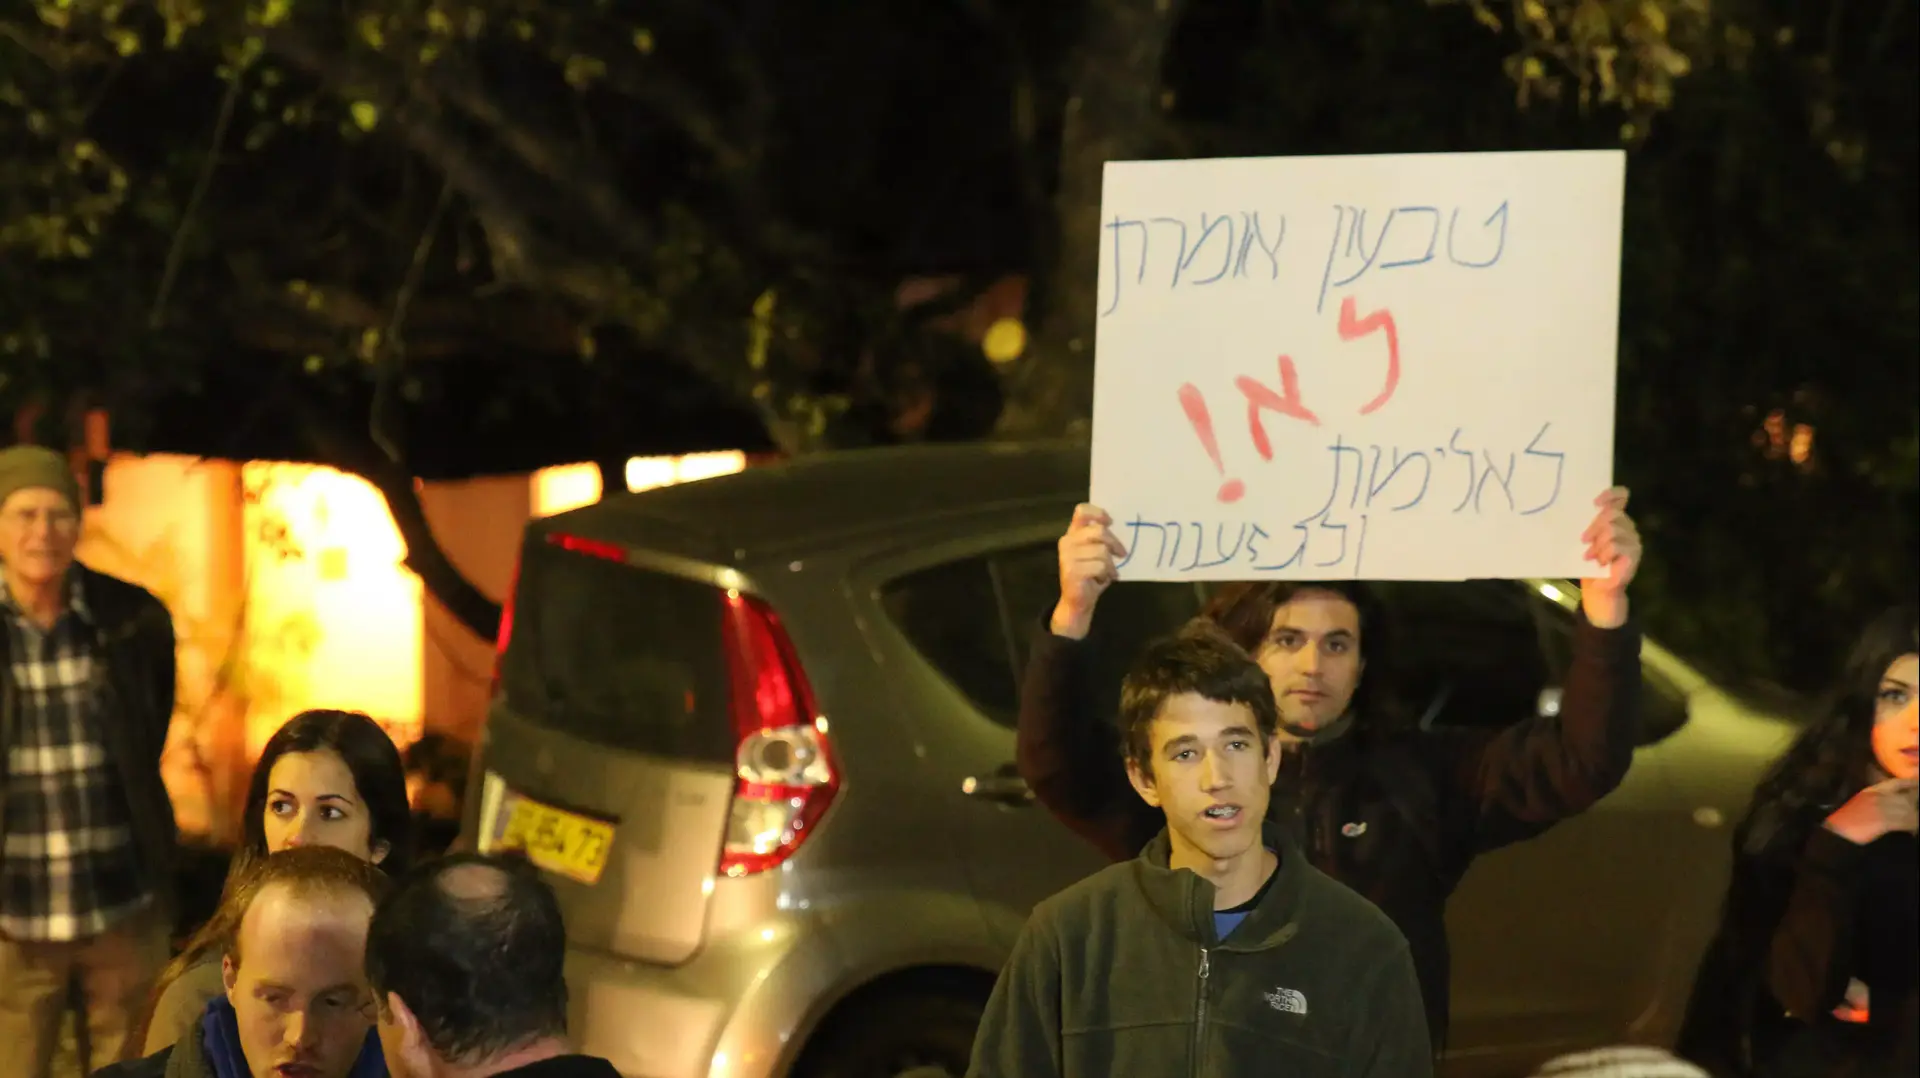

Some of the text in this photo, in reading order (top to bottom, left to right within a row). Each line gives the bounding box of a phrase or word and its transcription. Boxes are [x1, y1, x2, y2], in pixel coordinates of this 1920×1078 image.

[1101, 200, 1508, 318] טבעון אומרת
[1300, 421, 1565, 523] לאלימות
